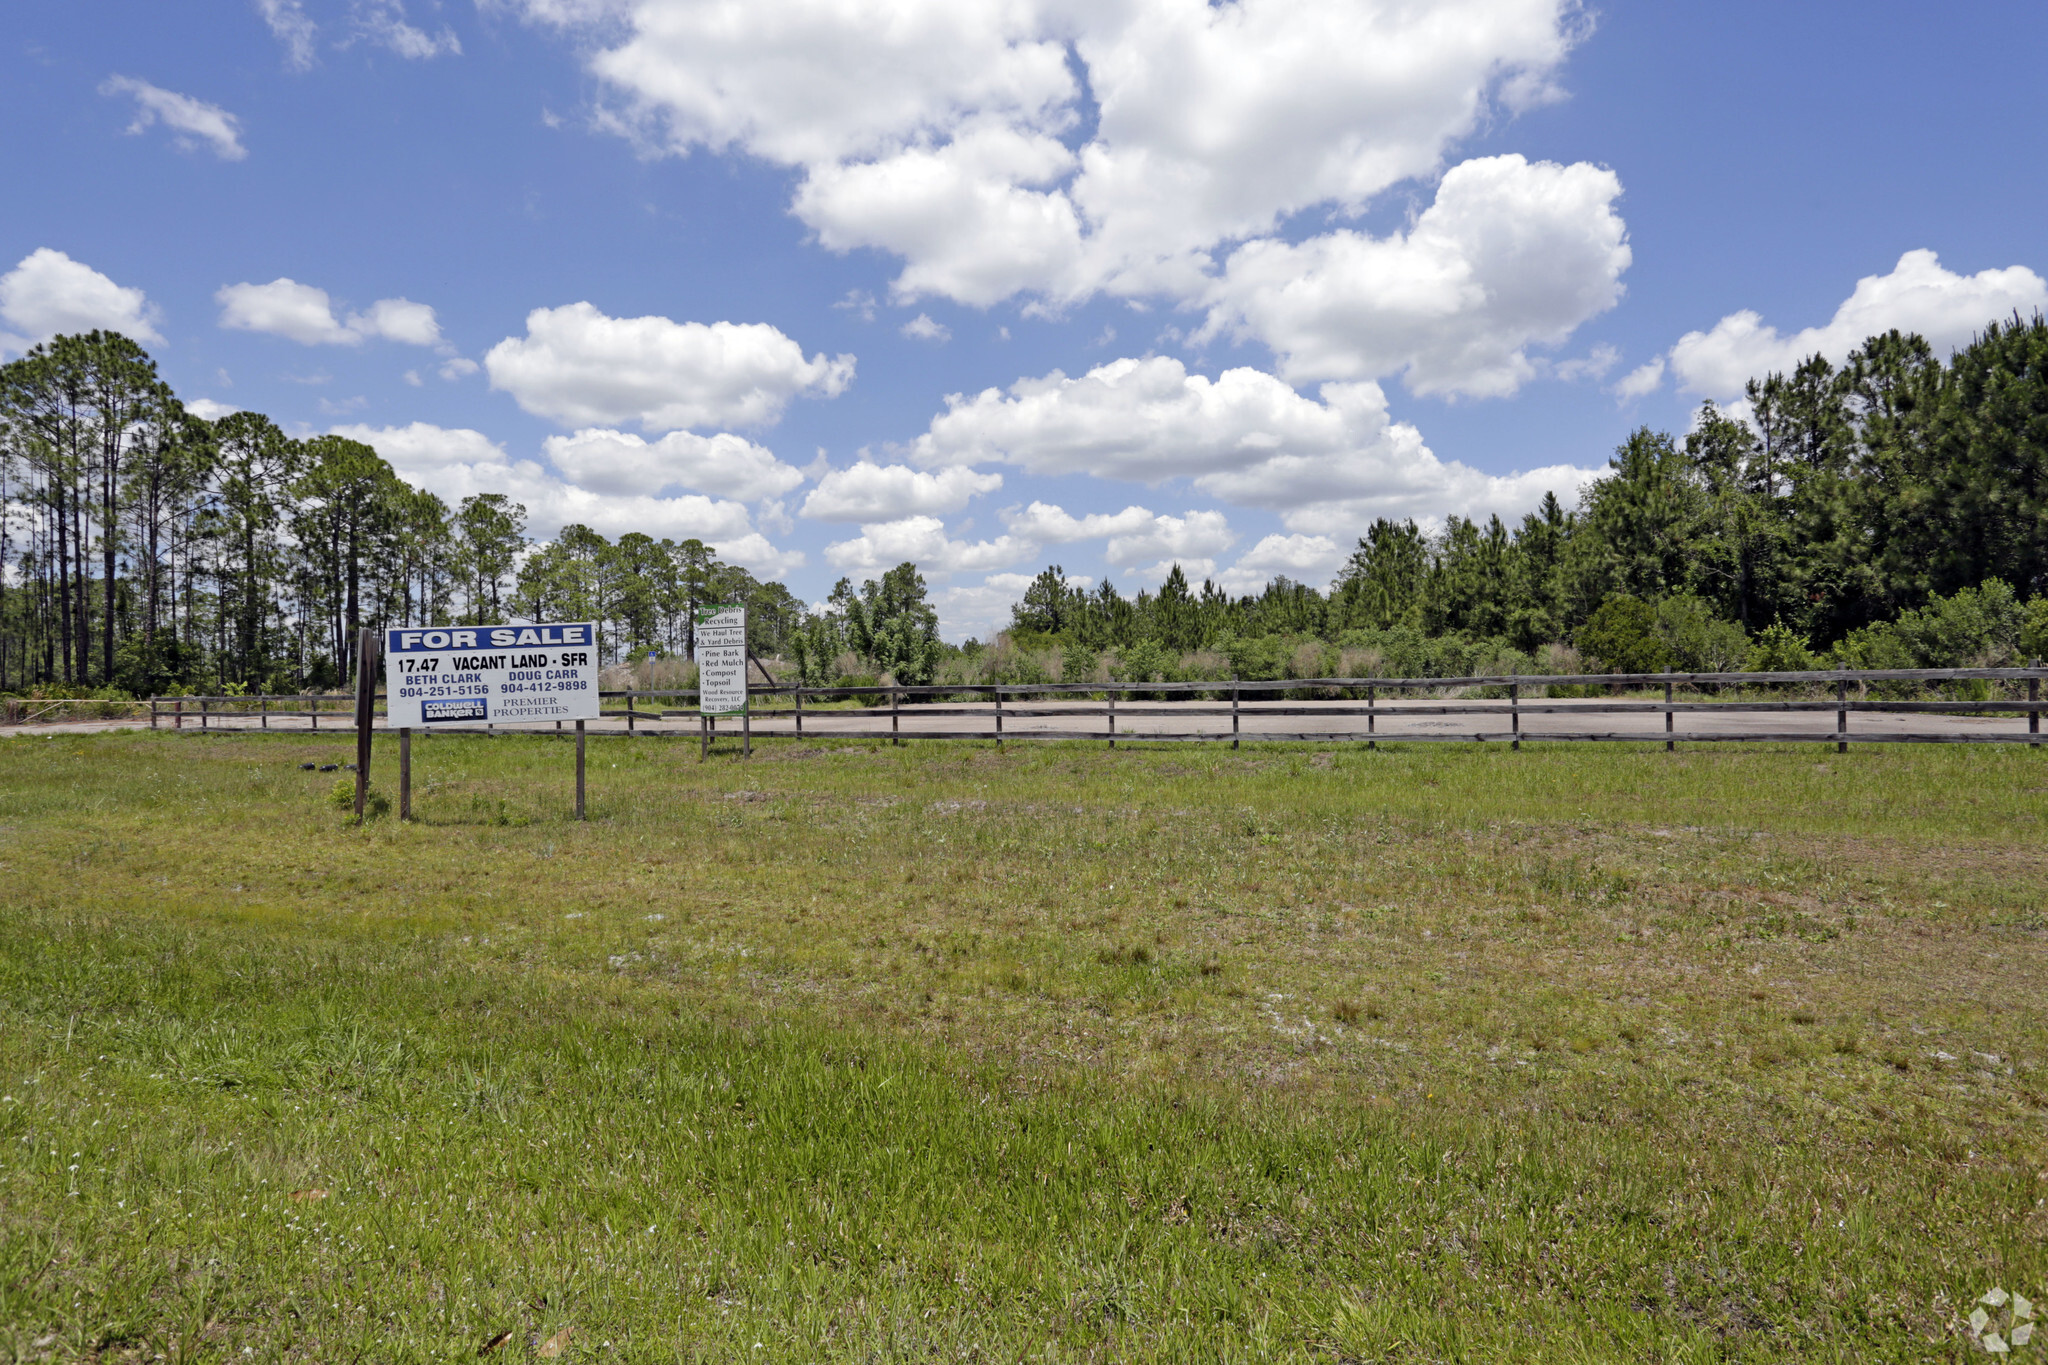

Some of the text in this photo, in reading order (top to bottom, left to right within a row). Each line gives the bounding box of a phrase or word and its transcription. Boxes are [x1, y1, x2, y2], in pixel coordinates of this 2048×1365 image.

[718, 605, 742, 614] Debris
[704, 617, 738, 625] Recycling
[401, 627, 584, 650] FOR SALE
[398, 652, 588, 672] 17.47 VACANT LAND SFR
[406, 673, 482, 685] BETH CLARK
[509, 669, 578, 681] DOUG CARR
[706, 670, 736, 678] Compost
[501, 680, 587, 694] 904-412-9898
[706, 679, 730, 687] Topsoil
[400, 684, 489, 698] 904-251-5156
[504, 697, 558, 707] PREMIER
[426, 710, 474, 718] BANKER
[494, 706, 568, 717] PROPERTIES
